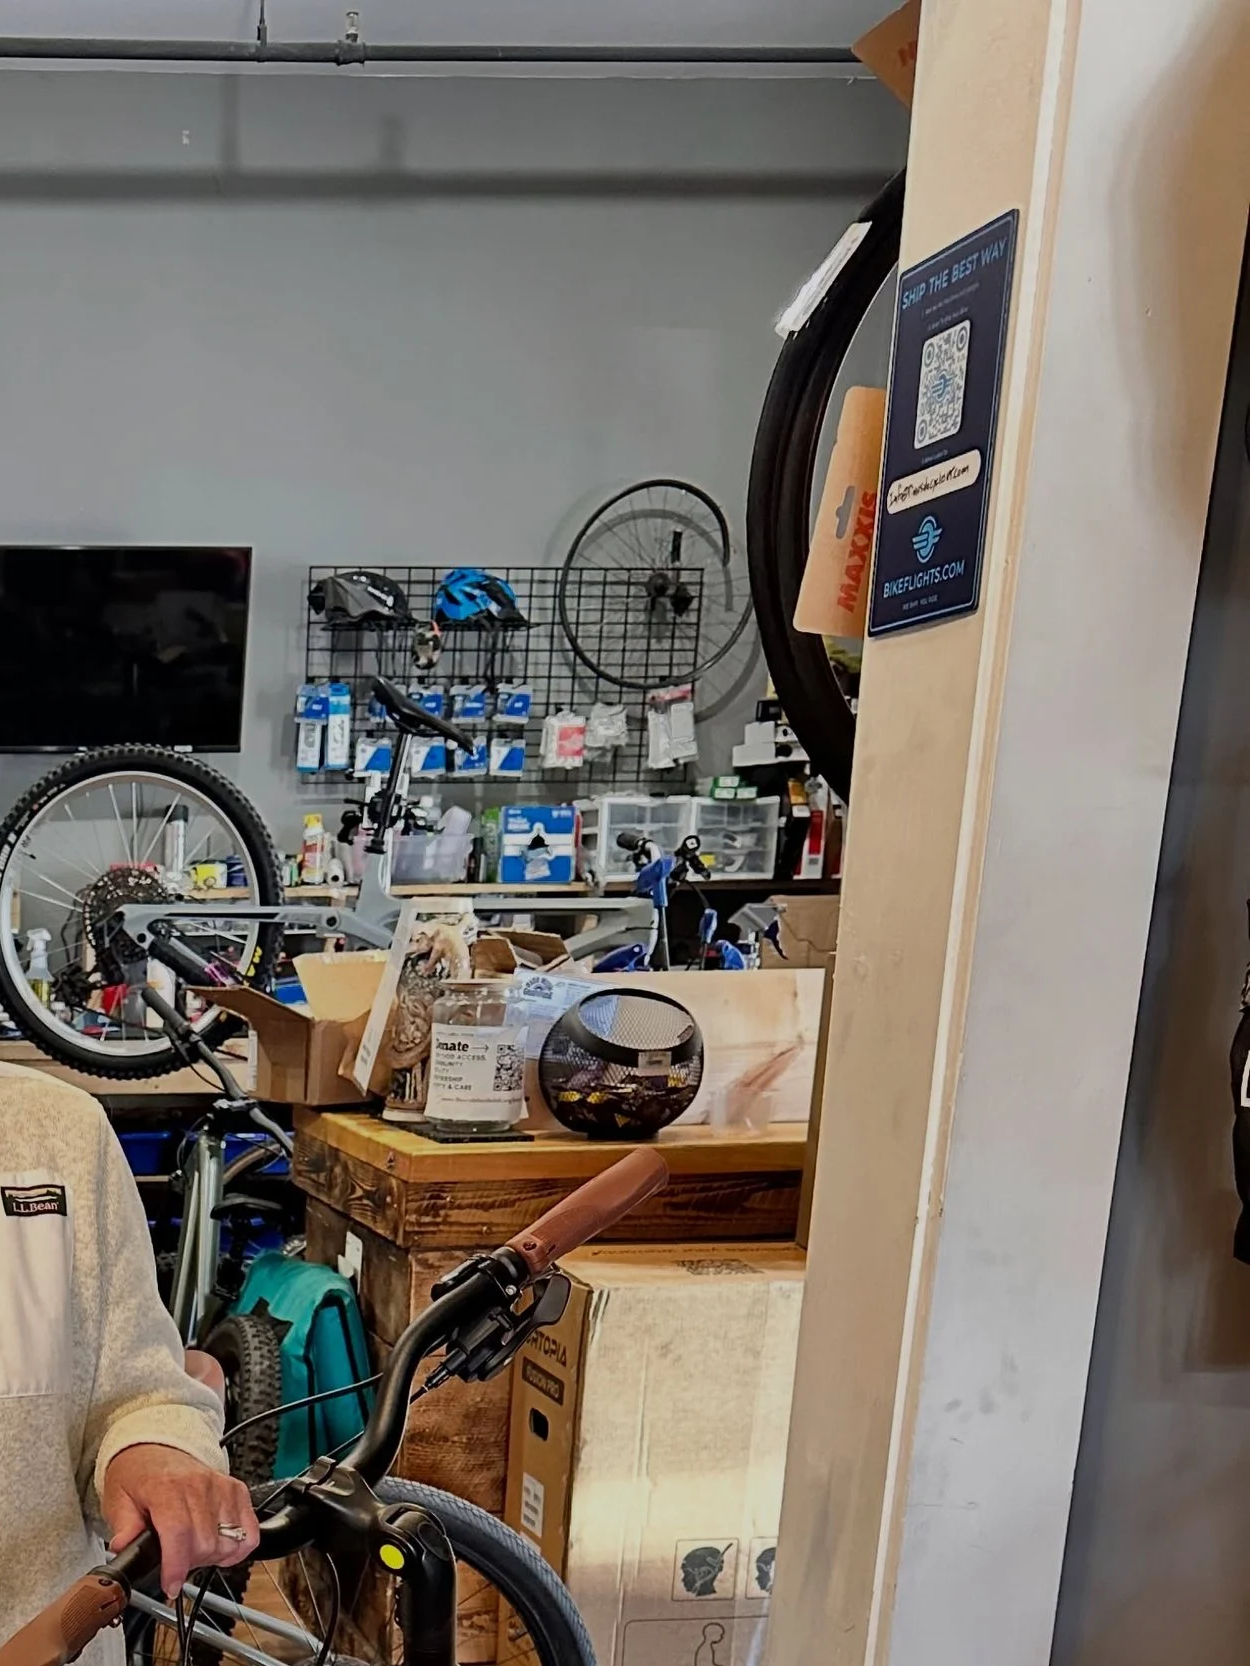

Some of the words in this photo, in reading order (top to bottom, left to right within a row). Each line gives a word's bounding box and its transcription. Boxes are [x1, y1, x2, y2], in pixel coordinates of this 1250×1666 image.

[901, 283, 926, 311] SHIP
[929, 269, 950, 294] THE
[951, 252, 979, 284] BEST
[980, 237, 1008, 267] WAY
[836, 489, 878, 614] MAXXIS
[882, 559, 966, 599] BIKEFLIGHTS.COM
